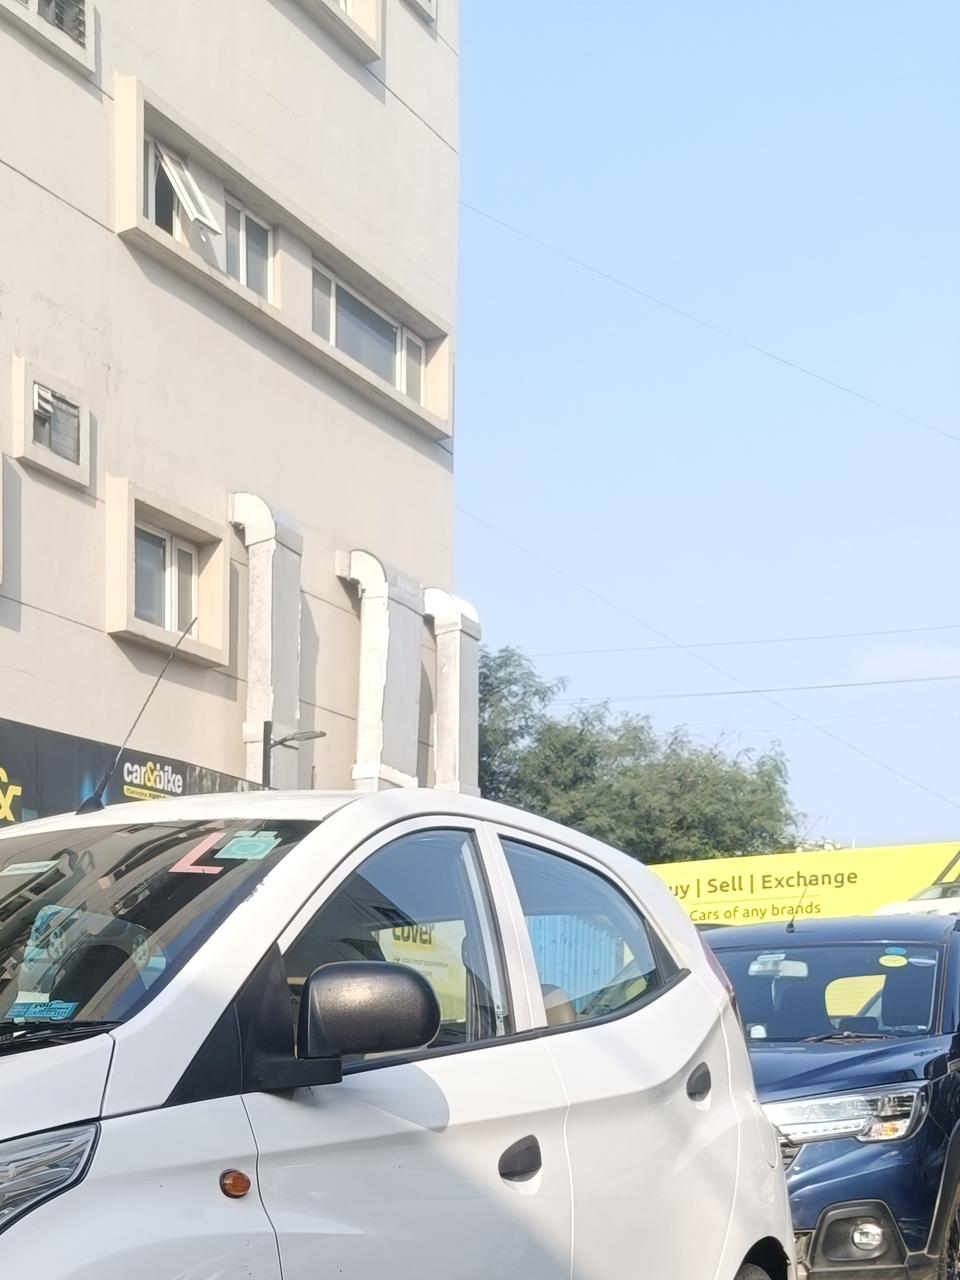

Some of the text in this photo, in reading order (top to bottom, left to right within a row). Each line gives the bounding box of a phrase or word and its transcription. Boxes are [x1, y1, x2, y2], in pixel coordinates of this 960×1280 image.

[123, 761, 183, 794] car&bike
[707, 875, 744, 894] Sell
[761, 871, 858, 889] Exchange
[690, 901, 822, 921] Cars of any brands
